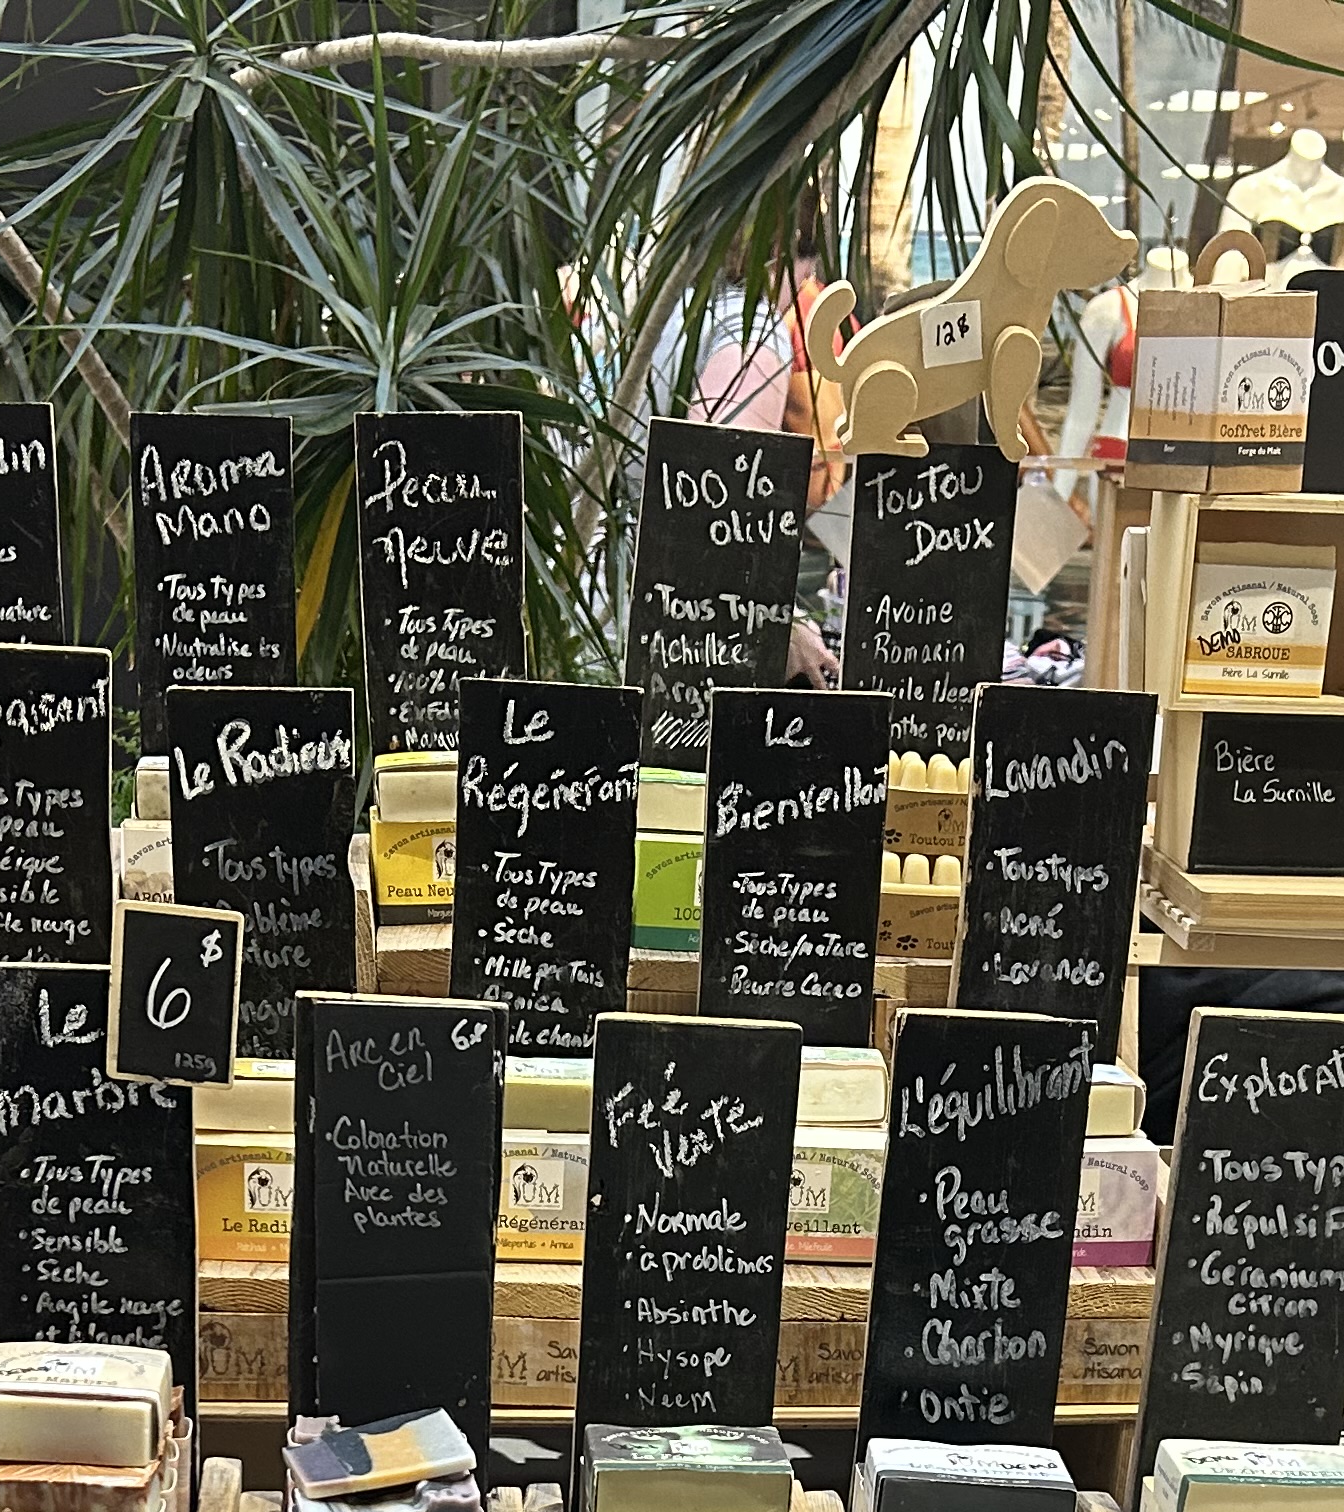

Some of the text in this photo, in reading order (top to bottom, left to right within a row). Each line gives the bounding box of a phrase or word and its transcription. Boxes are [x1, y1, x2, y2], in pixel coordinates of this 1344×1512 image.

[1219, 422, 1303, 439] Coffret Bière
[710, 509, 798, 546] olive
[172, 603, 195, 622] de
[876, 594, 953, 626] Avoine
[401, 639, 421, 659] de
[1226, 647, 1290, 661] SABROUE
[173, 663, 233, 681] odeurs
[504, 699, 555, 745] Le
[764, 707, 812, 747] Le
[986, 735, 1130, 801] Lavandin
[1214, 740, 1276, 773] Bière
[1234, 780, 1257, 803] La
[909, 834, 955, 848] Toutou
[497, 891, 518, 909] de
[741, 903, 762, 920] de
[994, 952, 1104, 987] Lavande
[39, 989, 105, 1048] Le
[331, 1115, 448, 1152] Coloration
[1204, 1149, 1282, 1183] Tous
[32, 1186, 61, 1214] de
[408, 1183, 449, 1207] des
[935, 1165, 1009, 1220] Peau
[354, 1208, 441, 1235] plantes
[32, 1226, 129, 1253] Sensible
[931, 1266, 1021, 1310] Mixte
[638, 1298, 757, 1327] Absinthe
[638, 1337, 732, 1380] Hysope
[922, 1318, 1047, 1367] Charbon
[1084, 1337, 1139, 1356] Savon
[1189, 1322, 1304, 1366] Myrique
[1180, 1362, 1264, 1402] Sapin
